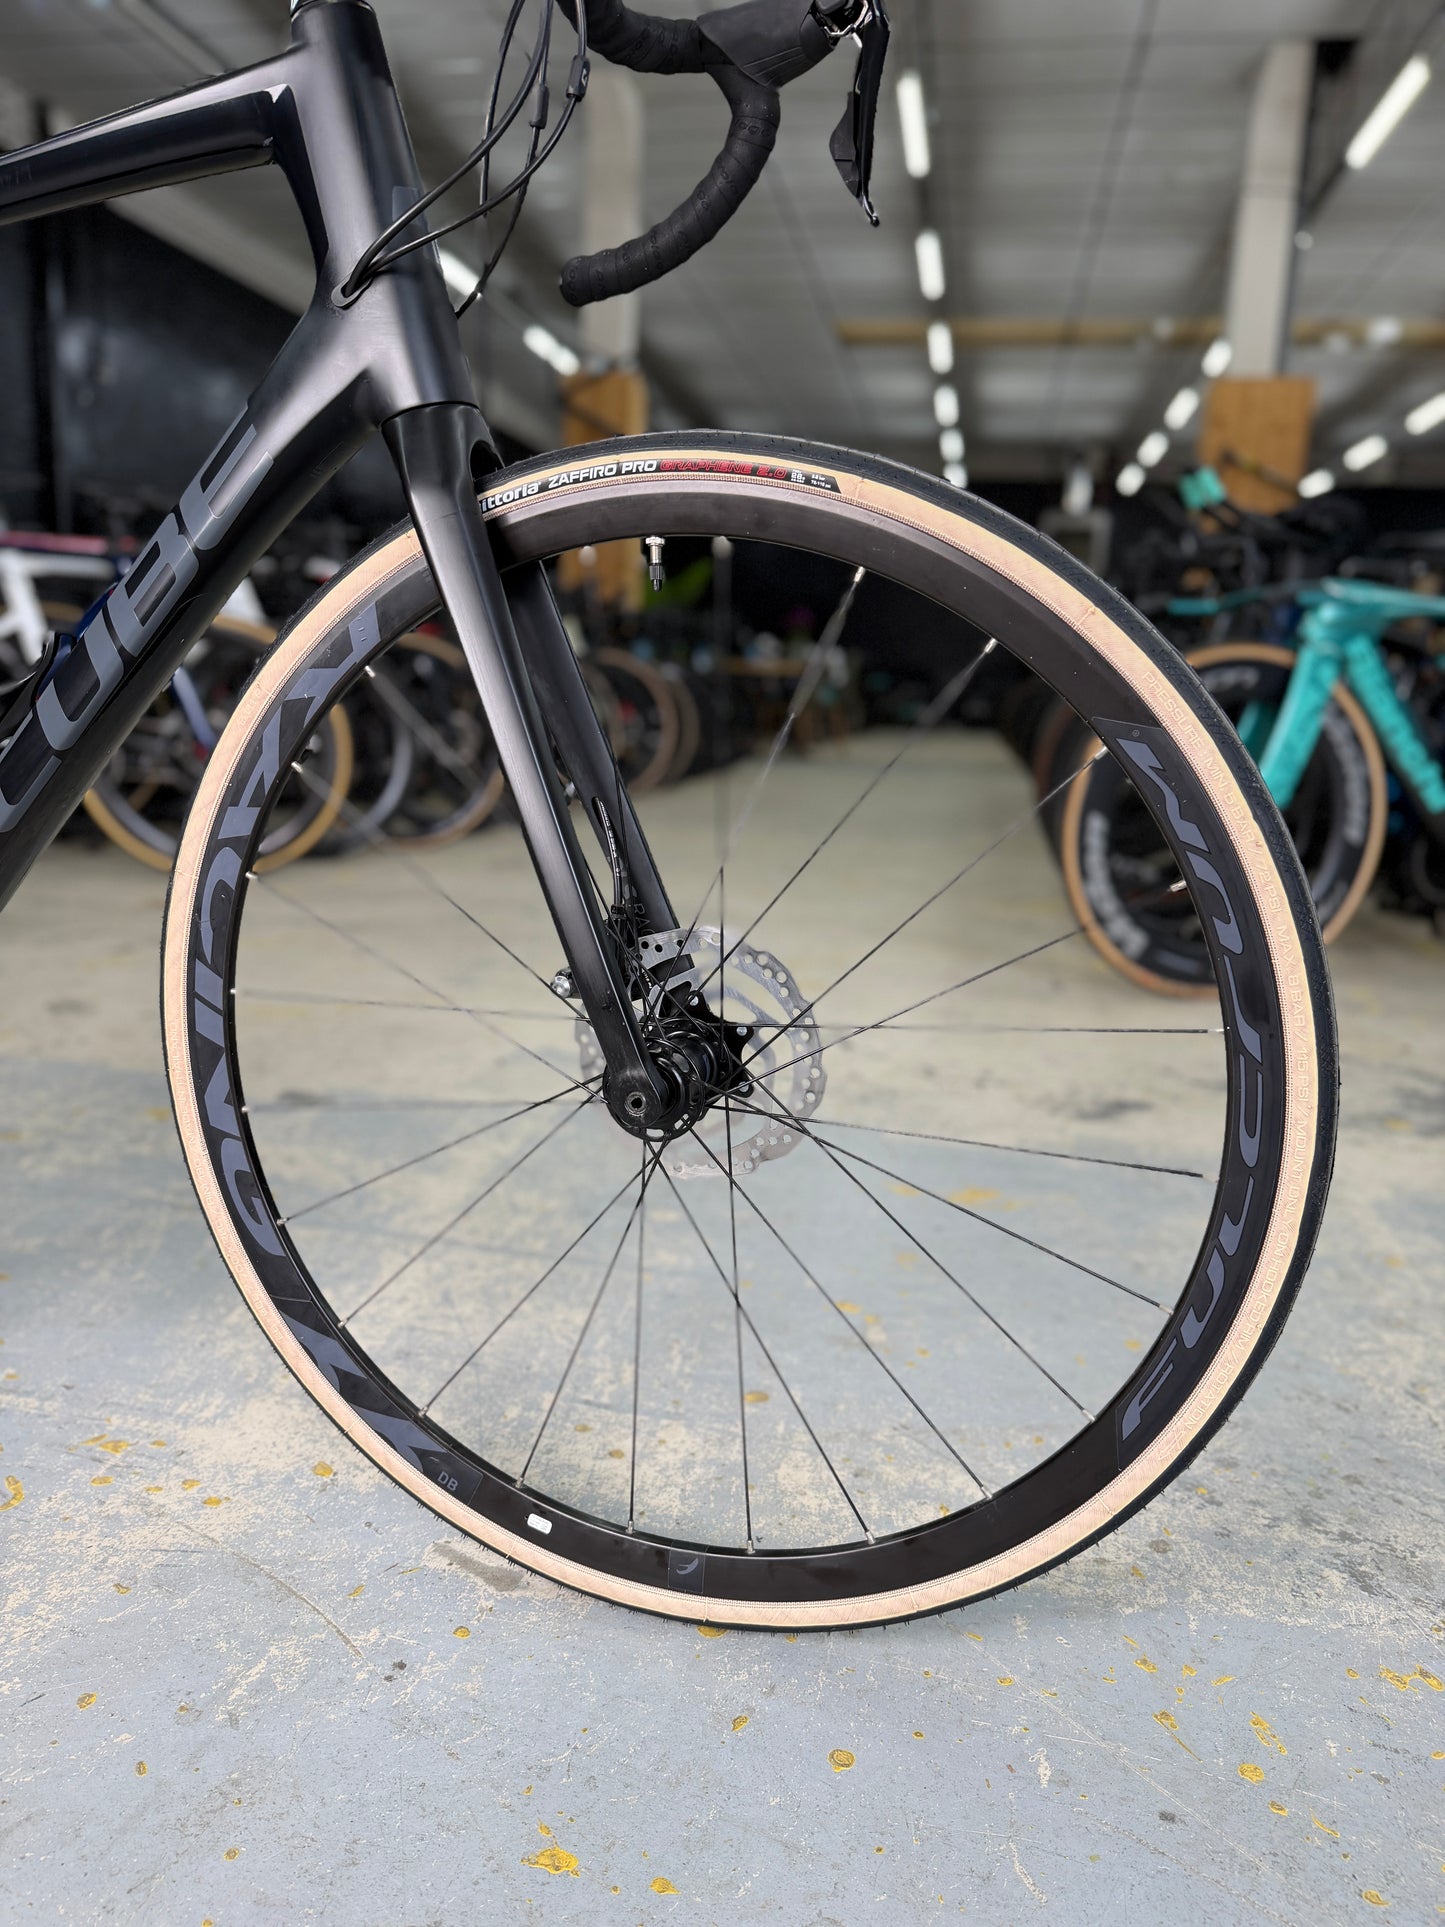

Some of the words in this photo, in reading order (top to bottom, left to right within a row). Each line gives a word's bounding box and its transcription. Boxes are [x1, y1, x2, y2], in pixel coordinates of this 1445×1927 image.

[480, 481, 541, 511] ittoria
[548, 464, 617, 488] ZAFFIRO
[621, 460, 657, 474] PRO
[660, 459, 752, 474] GRAPHENE
[756, 465, 787, 479] 2.0
[0, 400, 274, 833] CUBE
[1116, 737, 1264, 1441] FULCRUM
[1290, 1118, 1308, 1182] MOUNT
[1279, 1184, 1300, 1232] ONLY
[1272, 1230, 1290, 1258] ON
[1182, 1361, 1235, 1432] ROTATION
[436, 1468, 459, 1494] DB
